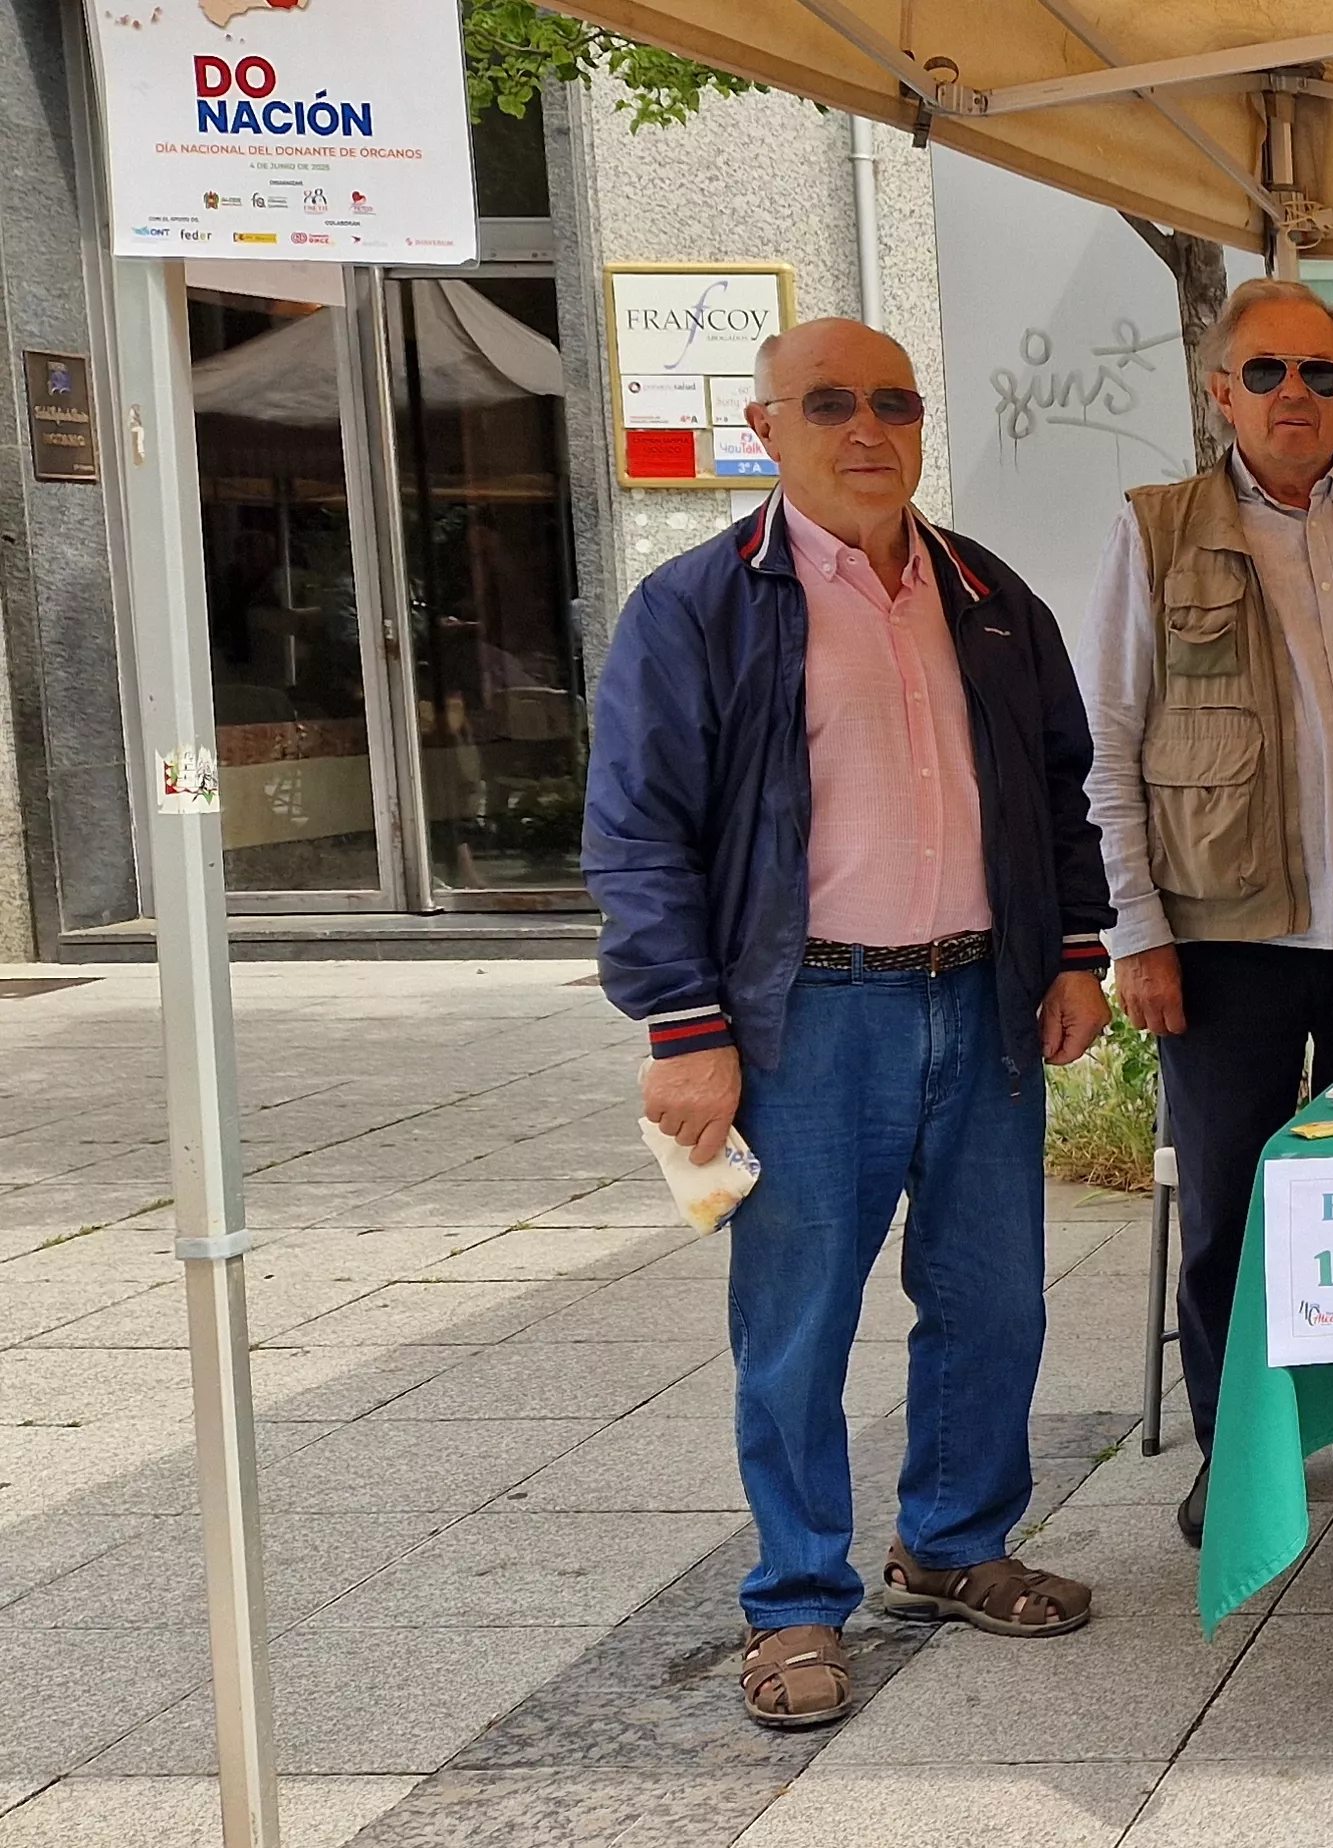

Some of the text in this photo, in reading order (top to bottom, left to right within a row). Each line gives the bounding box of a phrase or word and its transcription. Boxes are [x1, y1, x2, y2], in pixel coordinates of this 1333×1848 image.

[194, 55, 276, 99] DO
[197, 89, 373, 137] NACIÓN
[155, 142, 423, 159] DÍA NACIONAL DEL DONANTE DE ÓRGANOS
[180, 229, 212, 240] feder
